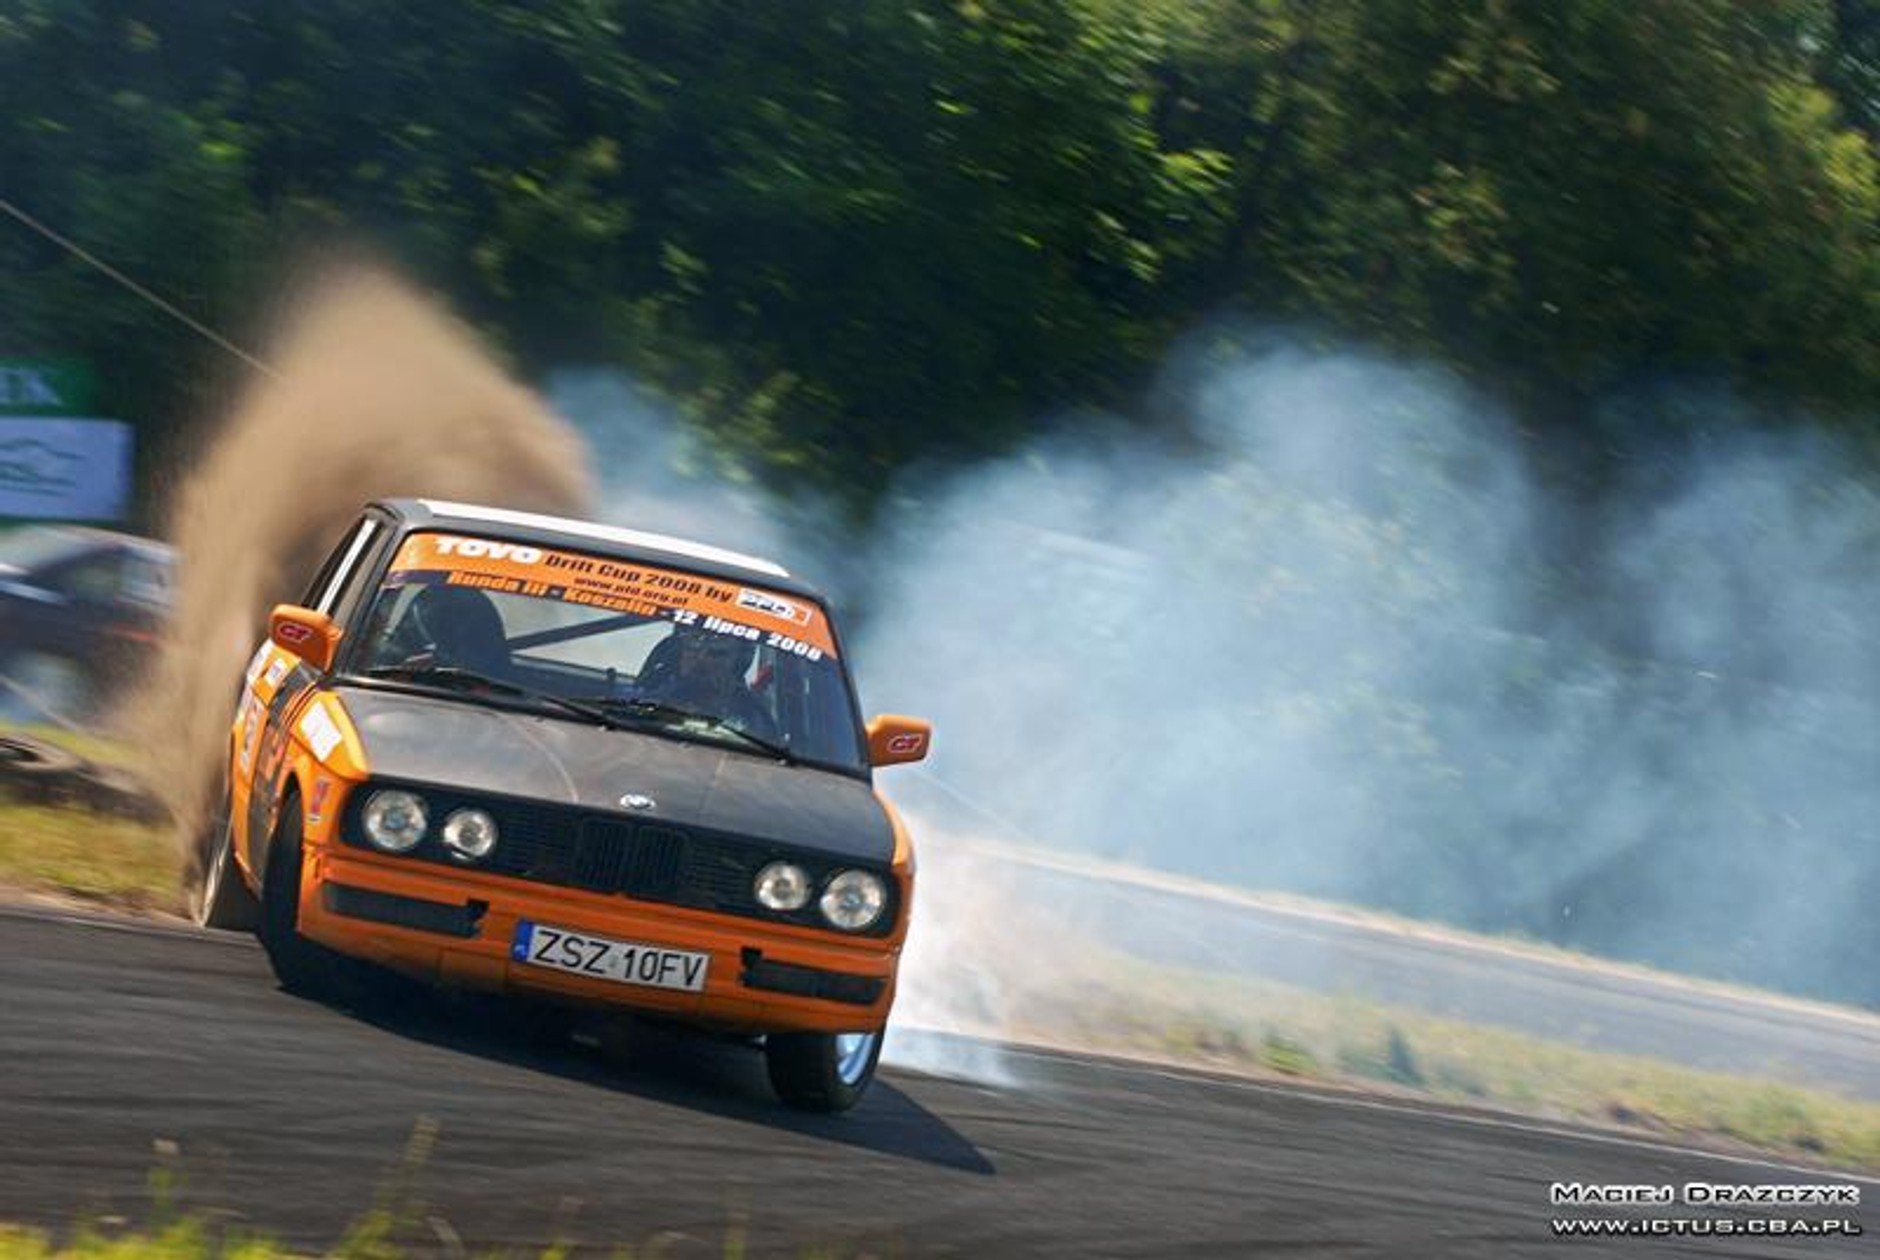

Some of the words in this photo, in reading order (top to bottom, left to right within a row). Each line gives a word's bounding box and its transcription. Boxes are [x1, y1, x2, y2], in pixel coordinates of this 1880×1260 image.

[545, 553, 594, 573] Drift
[598, 564, 641, 582] Cup
[644, 573, 700, 594] 2008
[705, 587, 733, 603] by
[448, 570, 519, 592] Runda
[563, 587, 657, 616] Koszalin
[673, 609, 699, 627] 12
[703, 615, 760, 641] lipca
[766, 631, 823, 662] 2008
[534, 930, 611, 975] ZSZ
[623, 948, 704, 987] 10FV
